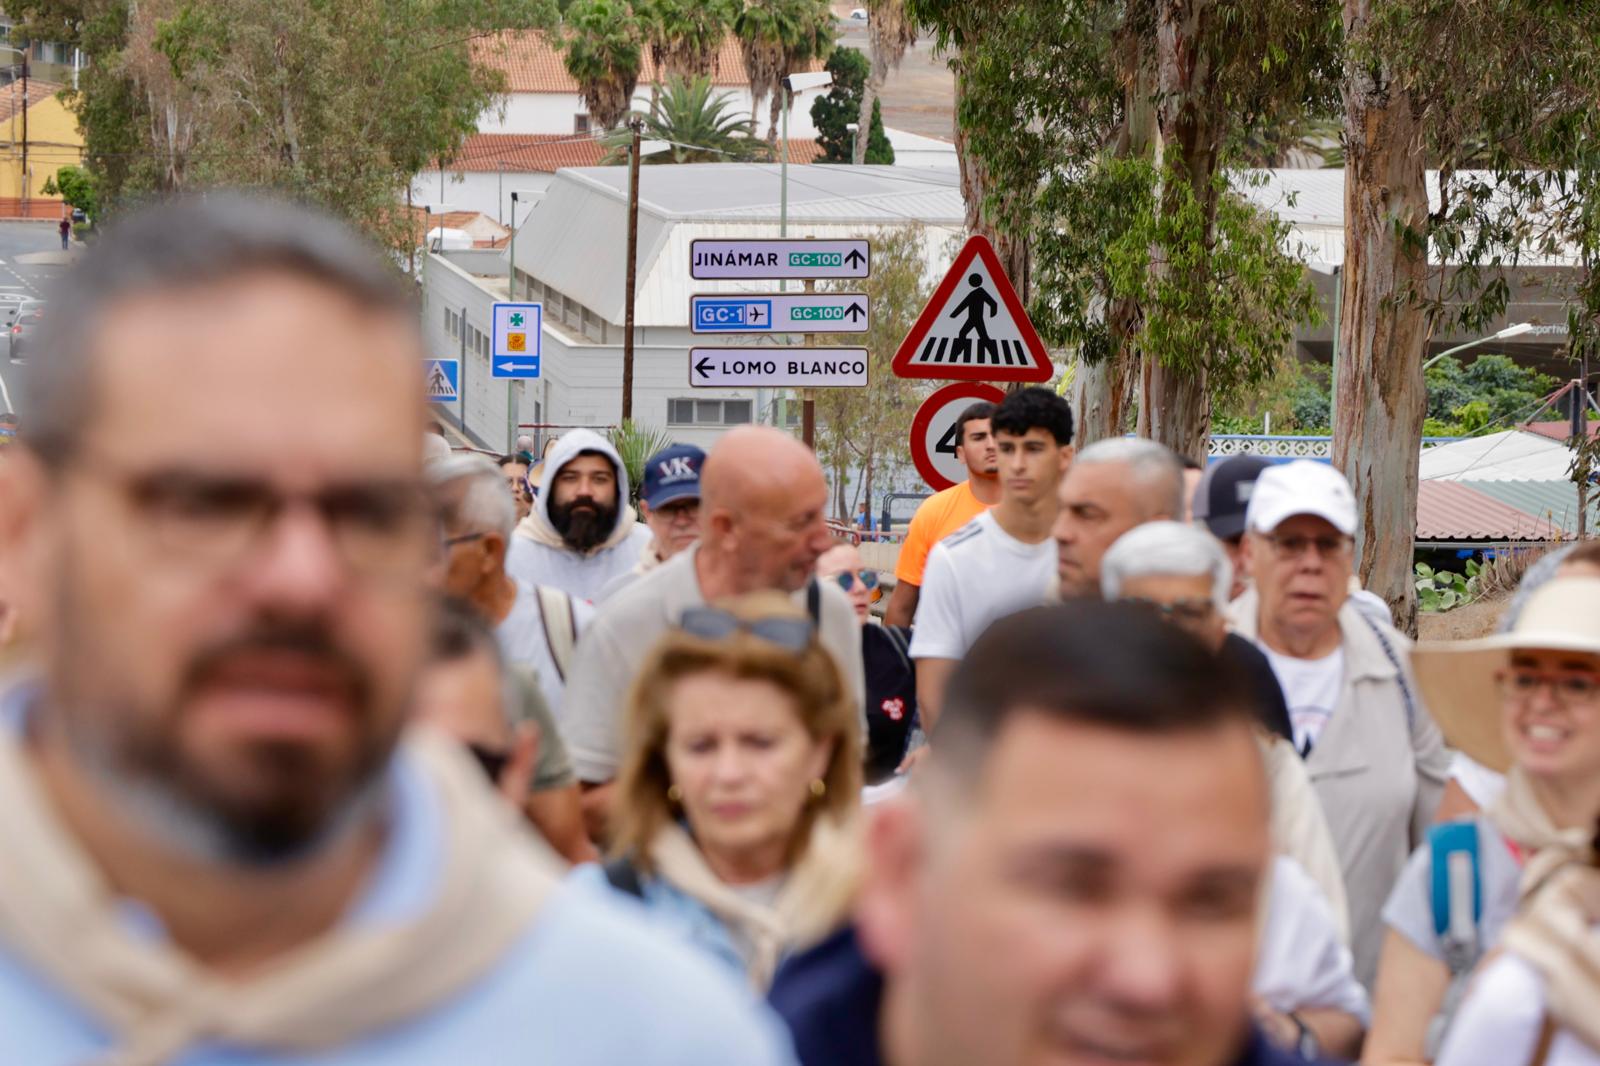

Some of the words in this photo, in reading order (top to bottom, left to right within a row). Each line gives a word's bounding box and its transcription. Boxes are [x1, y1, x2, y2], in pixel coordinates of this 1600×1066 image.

[695, 250, 778, 266] JINÁMAR
[790, 254, 841, 265] GC-100
[702, 307, 744, 322] GC-1
[792, 308, 842, 319] GC-100
[722, 361, 776, 375] LOMO
[788, 361, 865, 375] BLANCO
[935, 422, 958, 459] 4
